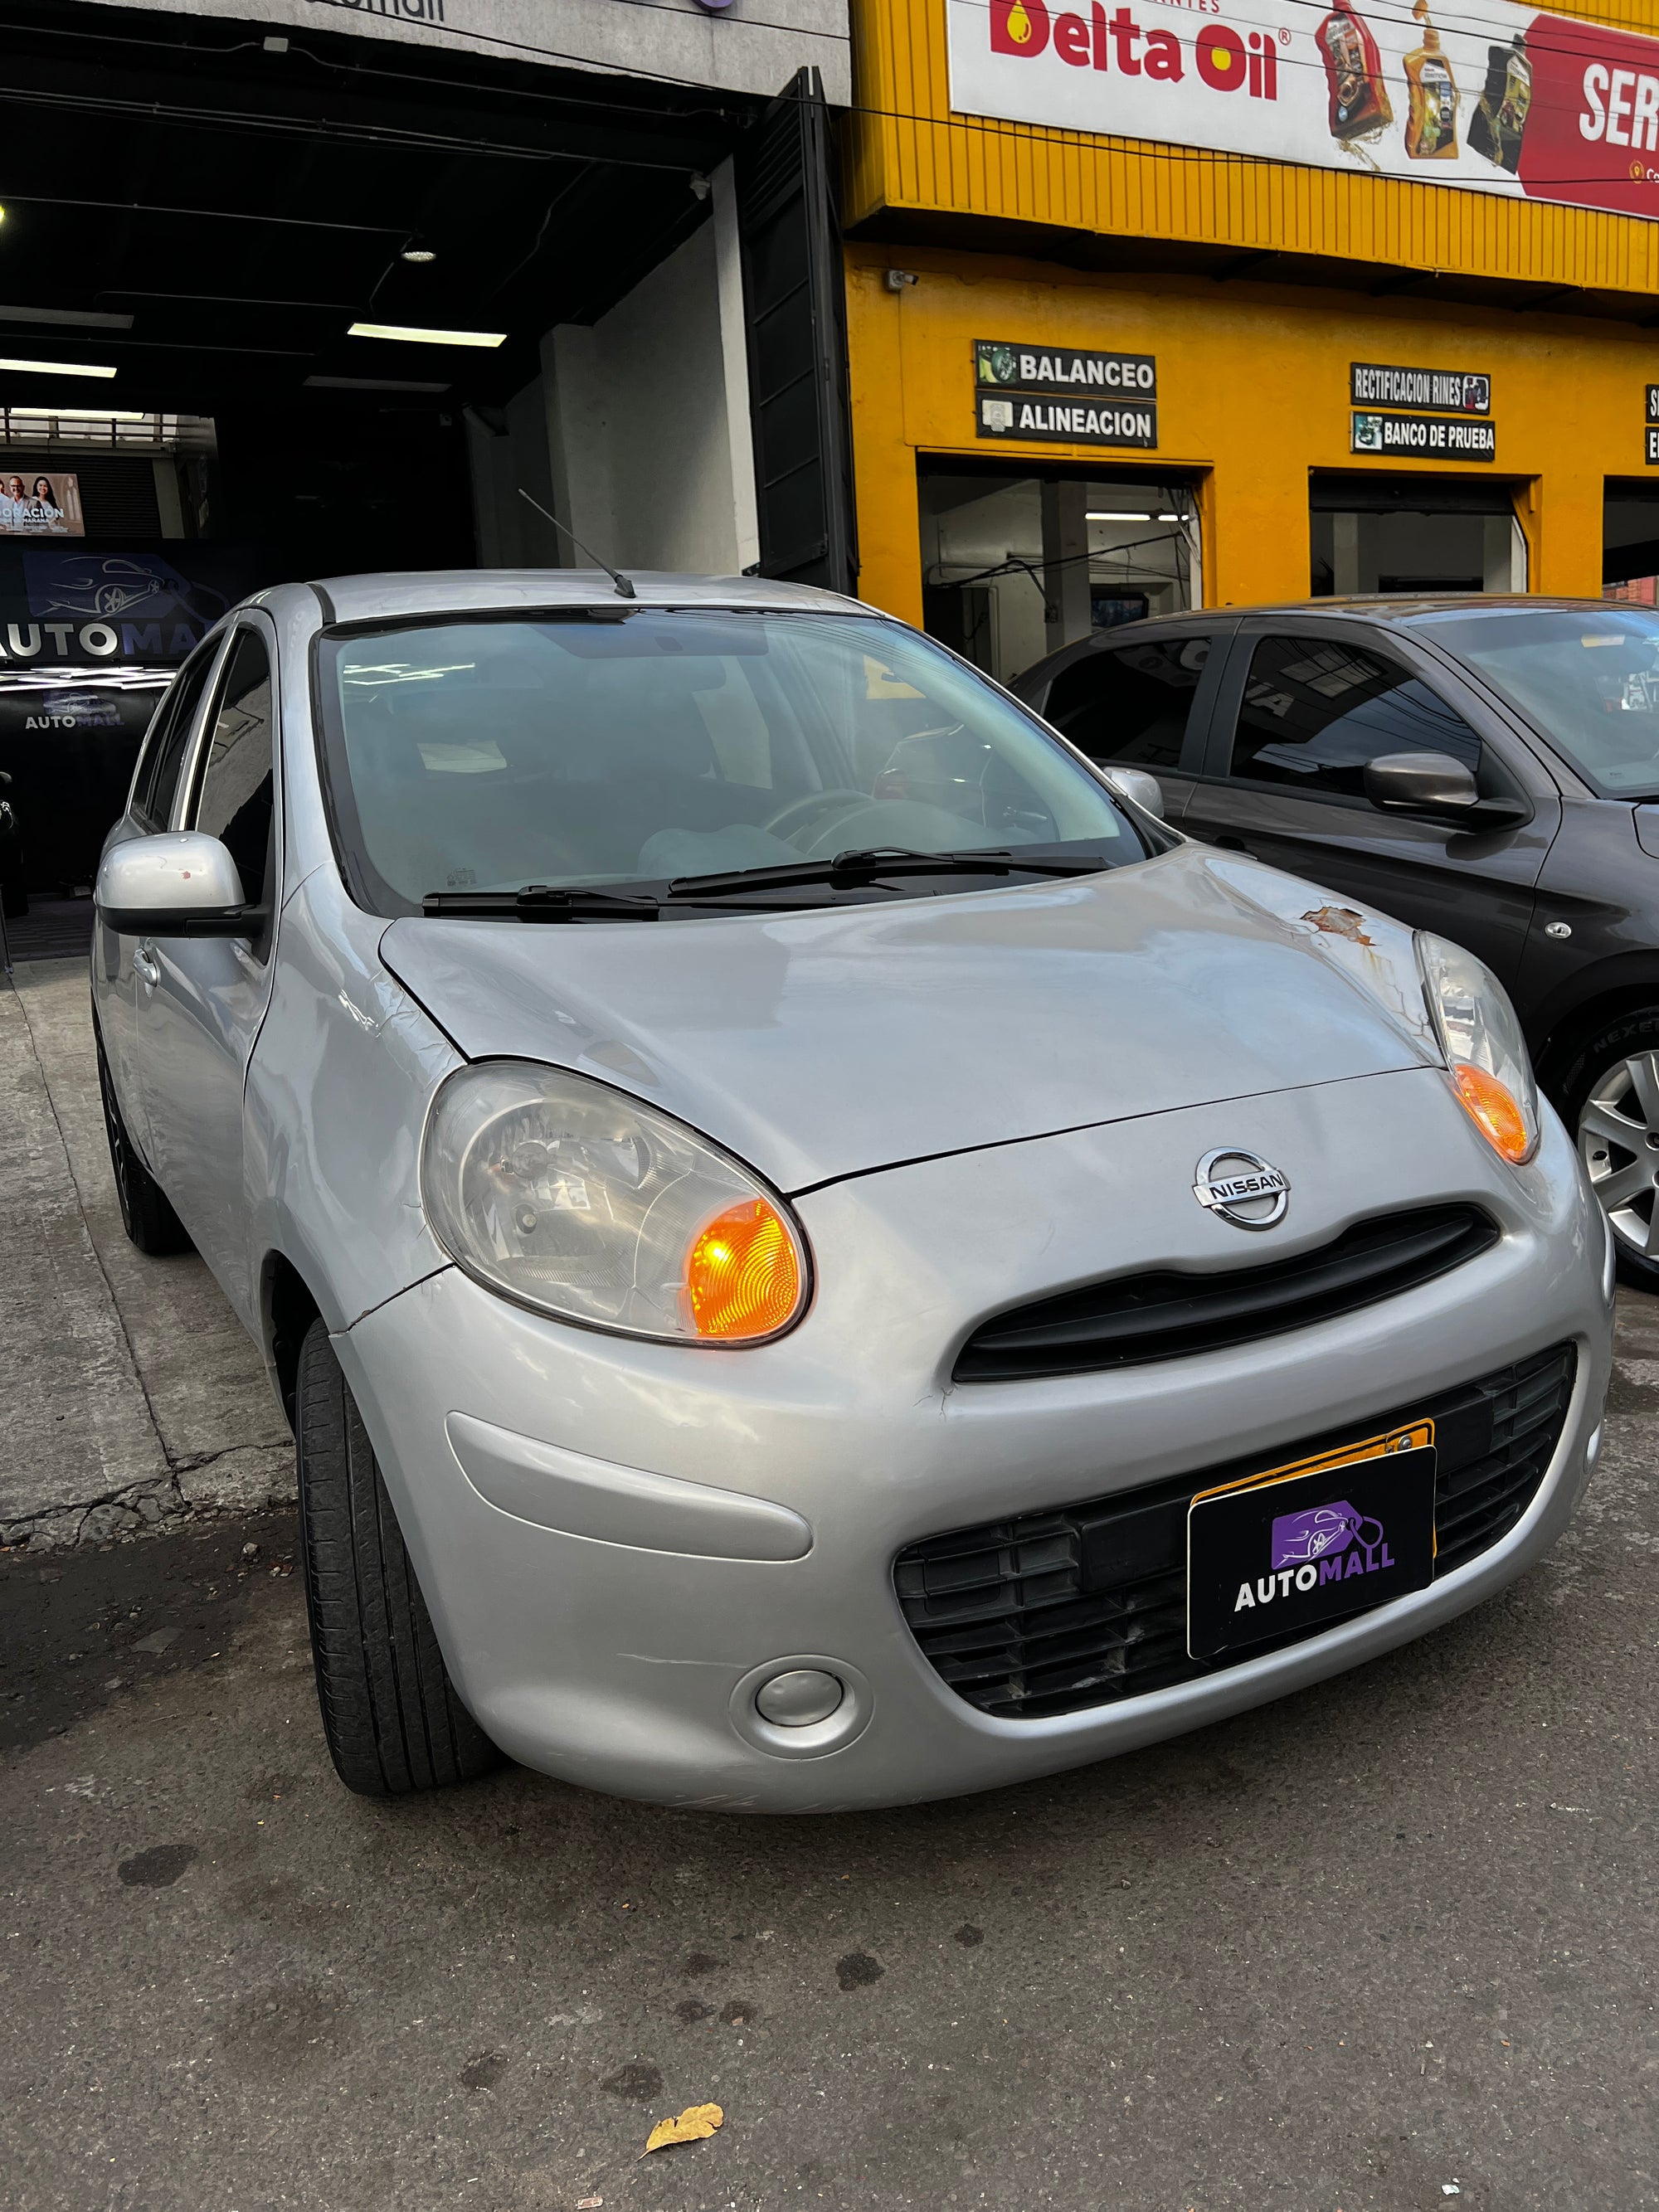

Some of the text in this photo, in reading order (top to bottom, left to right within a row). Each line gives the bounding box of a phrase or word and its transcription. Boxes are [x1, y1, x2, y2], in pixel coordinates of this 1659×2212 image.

[990, 0, 1277, 101] Delta Oil
[1019, 354, 1154, 389] BALANCEO
[1355, 367, 1461, 406] RECTIFICACION RINES
[1019, 404, 1151, 438] ALINEACION
[1384, 421, 1495, 450] BANCO DE PRUEBA
[26, 714, 124, 729] AUTOMALL
[1209, 1174, 1283, 1199] NISSAN
[1234, 1543, 1395, 1612] AUTOMALL
